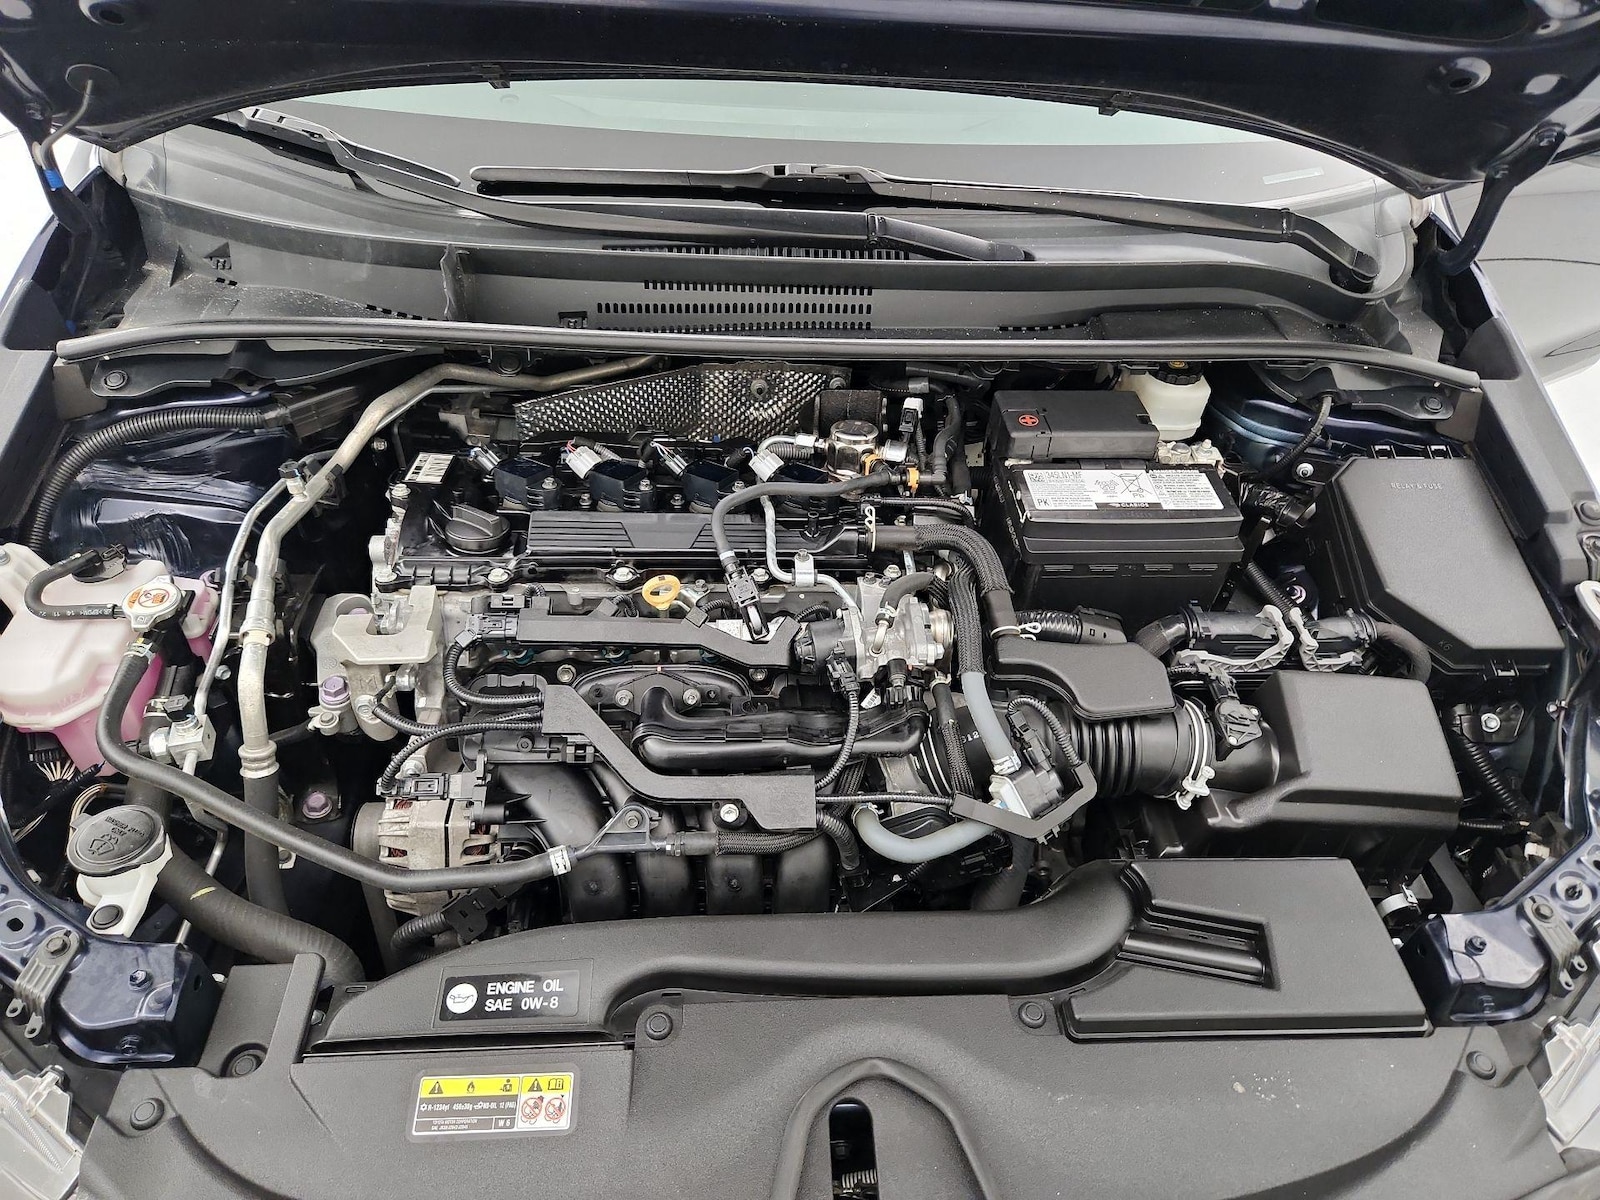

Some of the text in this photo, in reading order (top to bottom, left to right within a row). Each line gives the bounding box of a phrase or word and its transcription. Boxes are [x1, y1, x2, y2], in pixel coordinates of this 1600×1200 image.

[486, 978, 564, 995] ENGINE OIL
[485, 996, 559, 1012] SAE 0W-8
